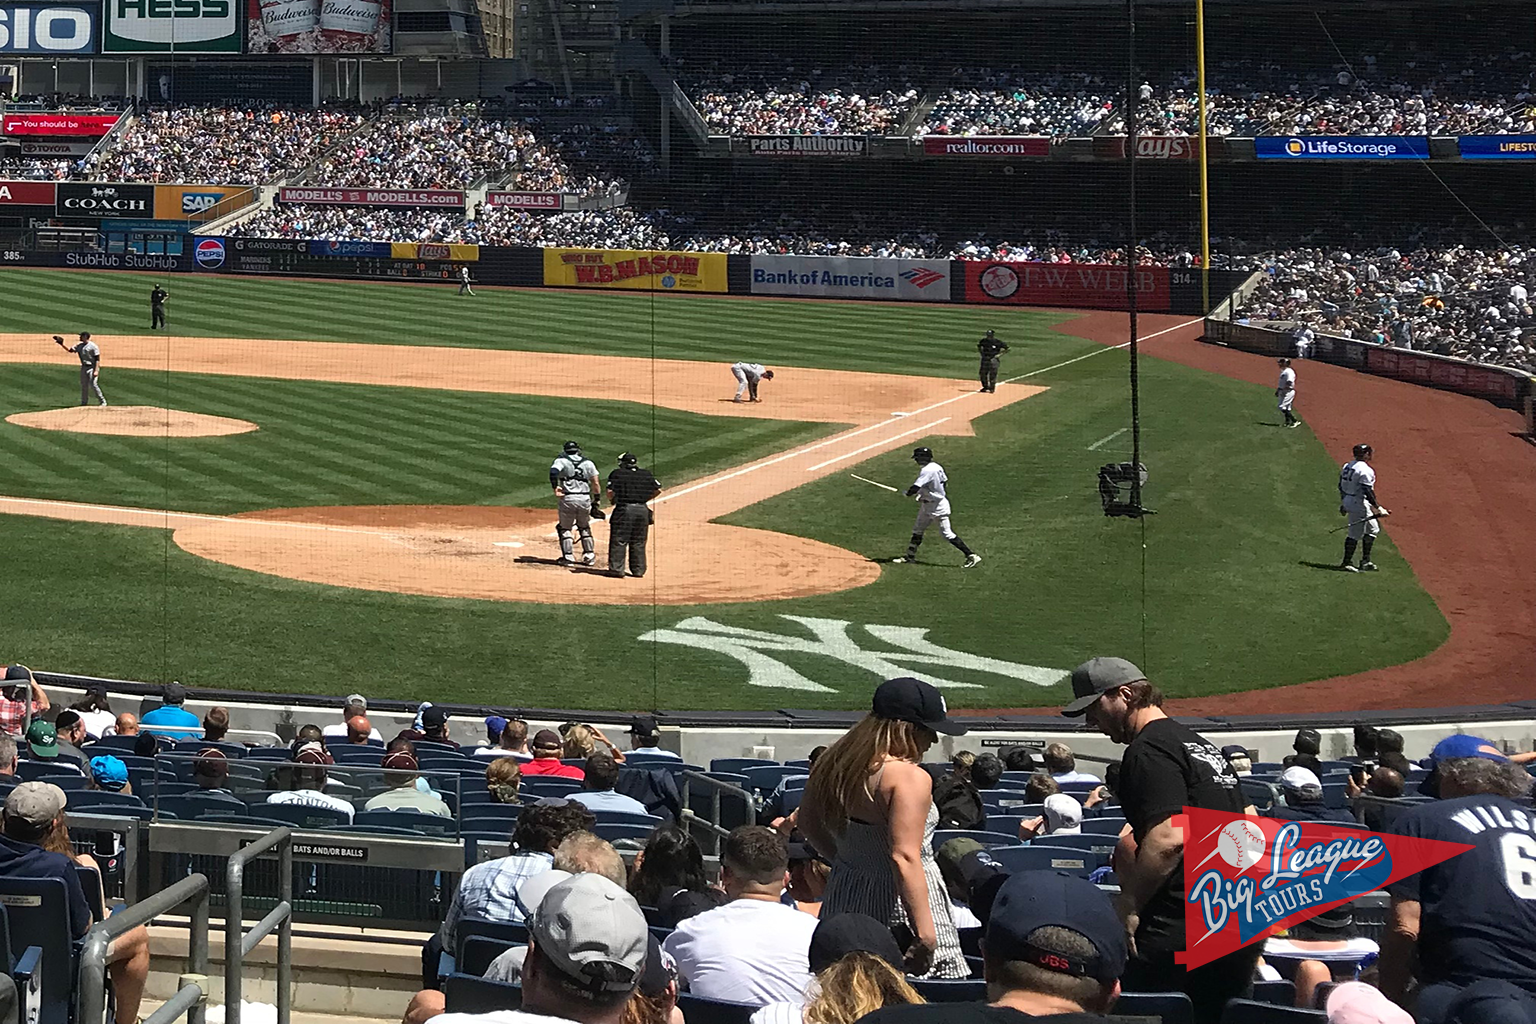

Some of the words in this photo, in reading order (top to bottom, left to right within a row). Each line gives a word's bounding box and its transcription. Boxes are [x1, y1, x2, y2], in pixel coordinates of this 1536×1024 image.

[22, 120, 38, 129] You
[39, 121, 66, 129] should
[67, 121, 79, 129] be
[37, 144, 71, 153] TOYOTA
[750, 137, 790, 151] Parts
[792, 136, 864, 152] Authority
[946, 141, 1026, 155] realtor.com
[183, 193, 215, 210] SAP
[285, 189, 343, 203] MODELL'S
[366, 190, 459, 205] MODELLS.com
[493, 193, 555, 206] MODELL'S
[64, 198, 146, 211] COACH
[247, 241, 294, 251] GATORADE
[342, 242, 374, 256] pepsi
[3, 250, 20, 261] 385
[196, 250, 225, 258] PEPSI
[66, 252, 120, 267] StubHub
[125, 254, 178, 270] StubHub
[753, 269, 797, 284] Bank
[799, 270, 820, 285] of
[820, 271, 895, 288] America
[1172, 272, 1191, 284] 314
[1451, 805, 1536, 835] WILS
[293, 845, 312, 854] BATS
[313, 846, 340, 856] AND/OR
[340, 848, 364, 857] BALLS
